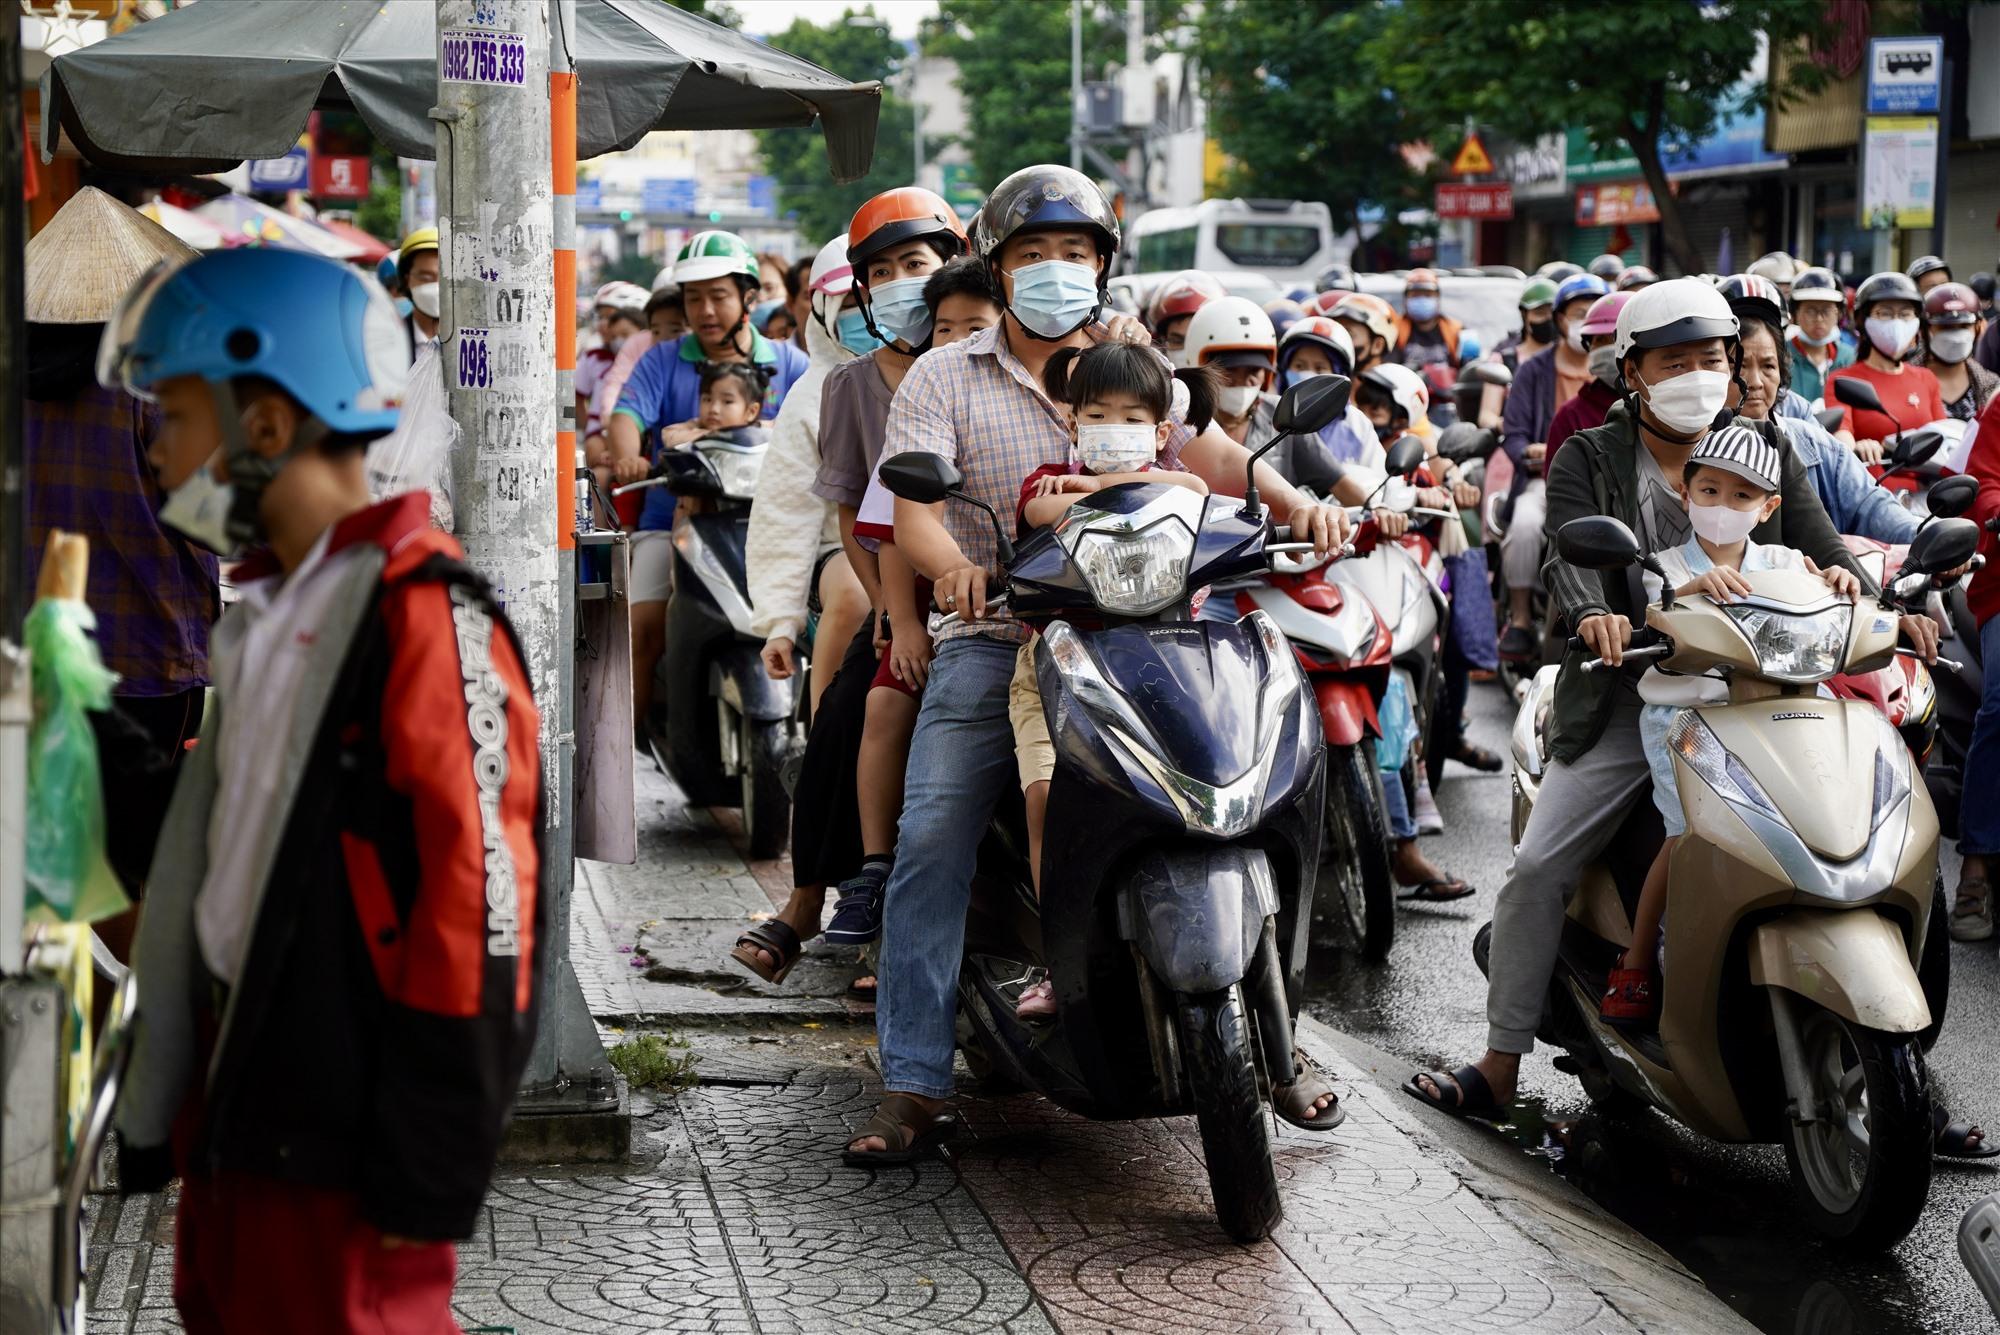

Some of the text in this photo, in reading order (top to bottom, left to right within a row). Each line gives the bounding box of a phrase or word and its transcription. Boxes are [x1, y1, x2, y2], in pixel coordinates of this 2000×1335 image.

[443, 40, 524, 84] 0982.756.333
[1147, 628, 1200, 636] HONDA
[1772, 712, 1825, 721] HONDA
